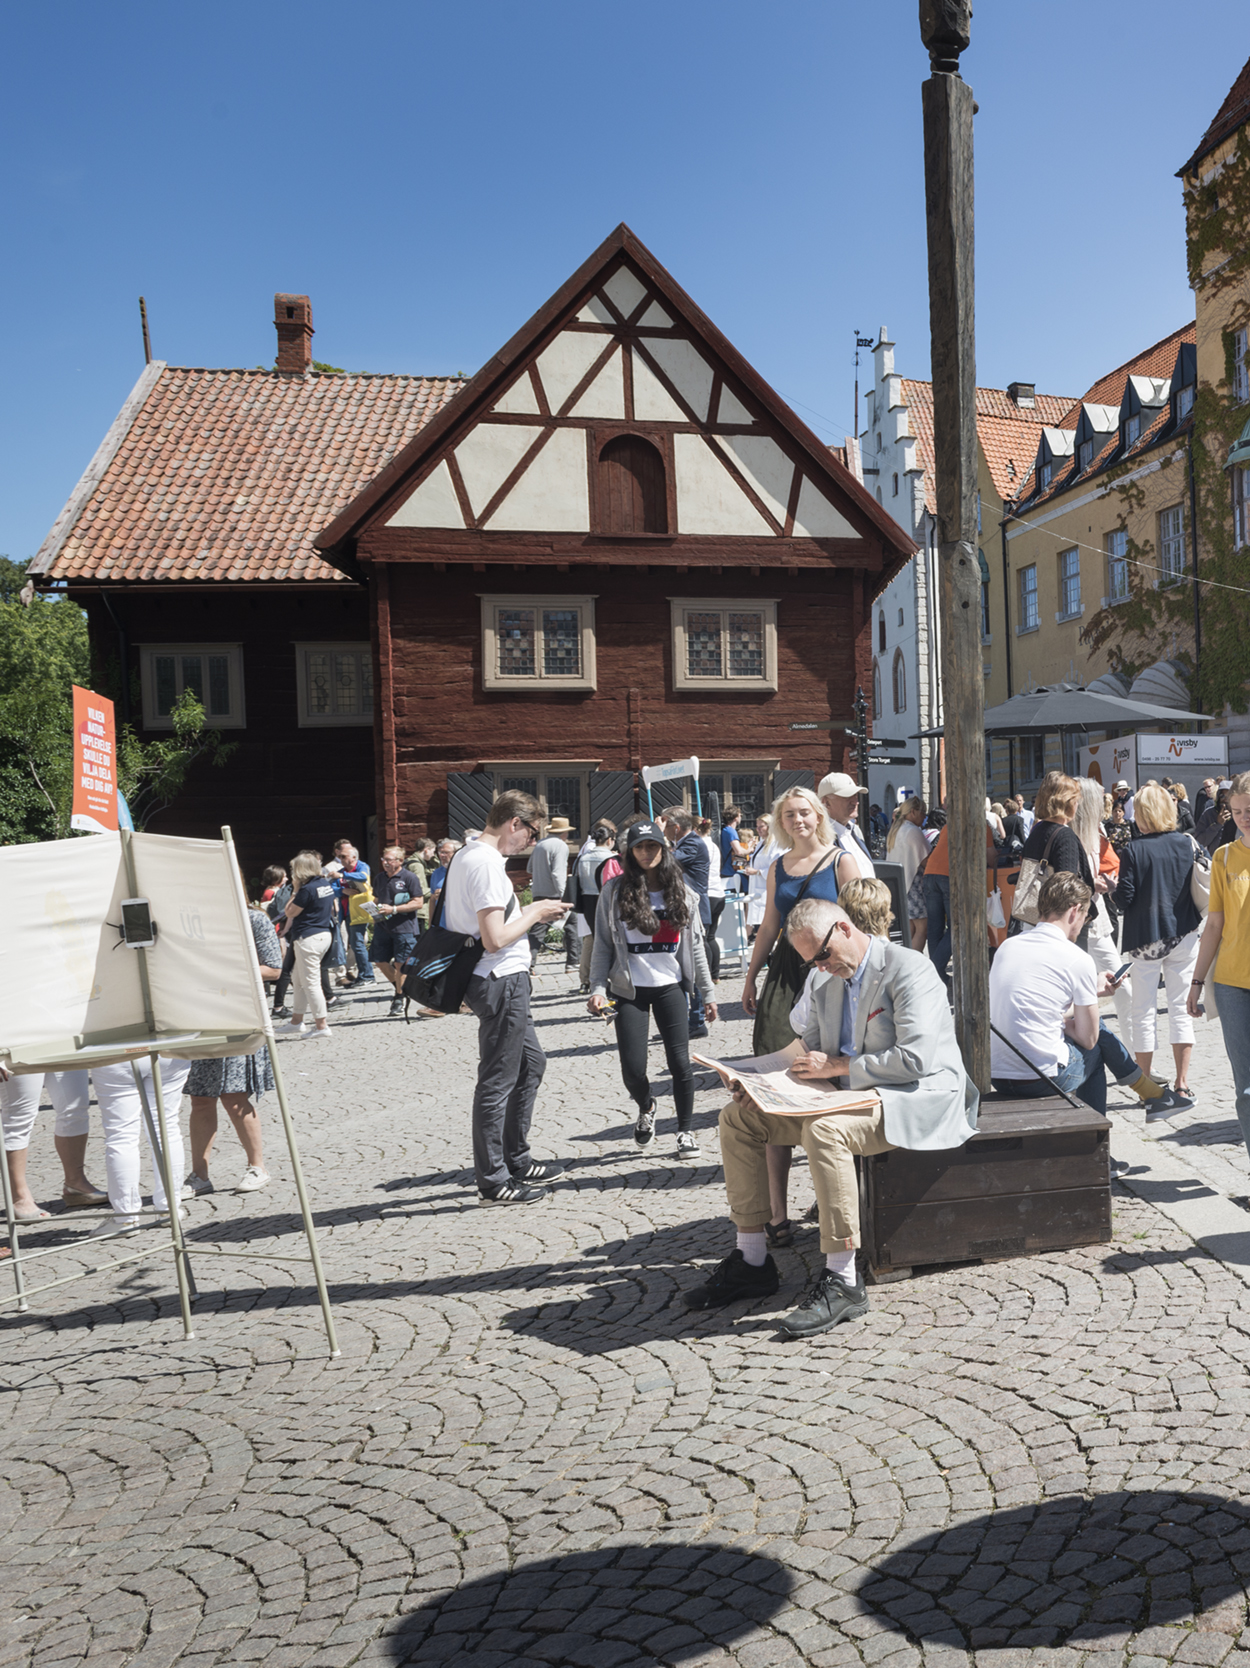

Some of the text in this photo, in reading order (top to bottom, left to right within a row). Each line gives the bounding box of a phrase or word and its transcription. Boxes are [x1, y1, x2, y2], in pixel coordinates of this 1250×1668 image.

[87, 707, 105, 724] VILKEN
[87, 721, 106, 737] NATUR-
[81, 733, 112, 754] UPPLEVELSE
[1177, 738, 1198, 748] ivisby
[83, 748, 111, 767] SKULLE DU
[82, 762, 112, 781] VILJA DELA
[81, 776, 94, 790] MED
[94, 779, 104, 793] DIG
